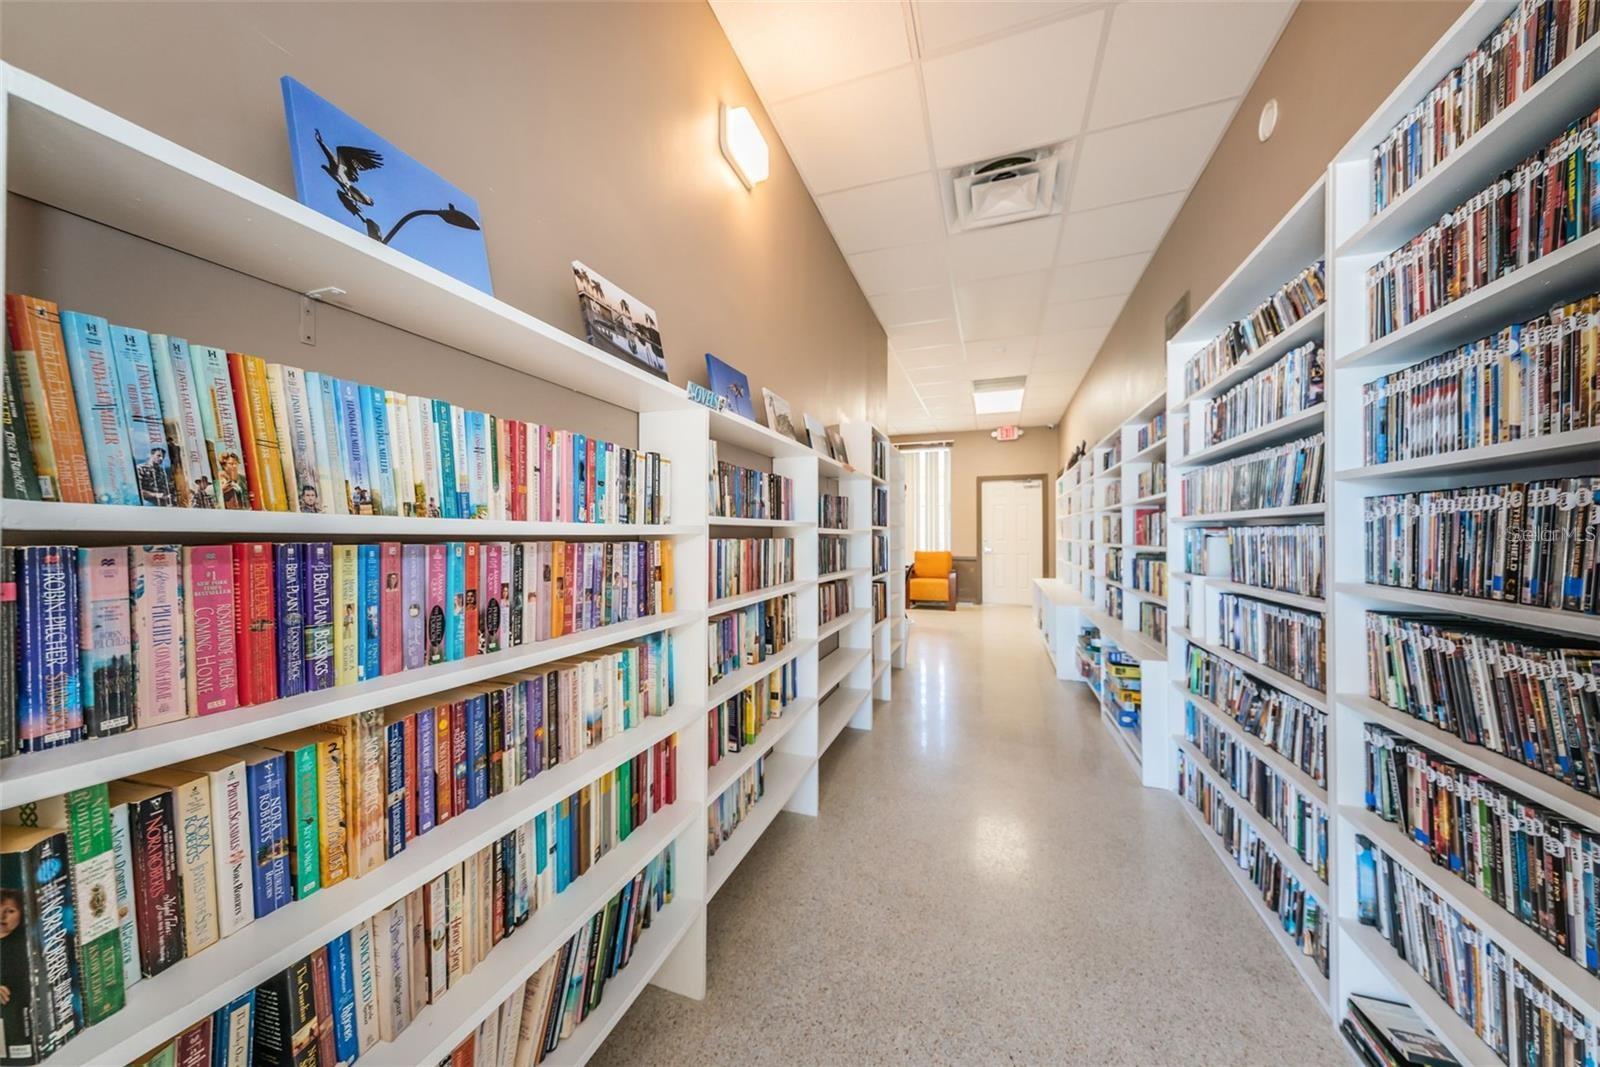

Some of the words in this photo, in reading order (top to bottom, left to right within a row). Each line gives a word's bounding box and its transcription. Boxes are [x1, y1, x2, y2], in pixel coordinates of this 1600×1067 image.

[38, 329, 60, 359] Linda
[44, 360, 66, 385] Lael
[88, 350, 106, 381] LINDA
[136, 364, 152, 390] LINDA
[176, 369, 189, 392] LINDA
[49, 386, 70, 422] Miller
[92, 383, 113, 405] LAEL
[140, 392, 154, 411] LAEL
[180, 393, 192, 410] LAEL
[214, 378, 228, 402] LINDA
[252, 388, 264, 412] LINDA
[290, 394, 302, 414] LINDA
[688, 381, 719, 410] NOVELS
[182, 411, 196, 436] MILLER
[218, 402, 232, 420] LAEL
[256, 413, 268, 430] LAEL
[292, 414, 304, 430] LAEL
[345, 402, 355, 422] LINDA
[374, 406, 384, 430] LINDA
[100, 408, 120, 446] MILLER
[144, 414, 162, 444] MILLER
[221, 422, 238, 450] MILLER
[294, 430, 308, 453] MILLER
[348, 422, 358, 438] LAEL
[376, 430, 386, 446] LAEL
[350, 439, 360, 462] MILLER
[378, 448, 388, 474] MILLER
[206, 570, 216, 580] #1
[286, 562, 298, 583] BELVA
[313, 573, 329, 598] BELVA
[42, 572, 66, 612] ROBIN
[254, 586, 270, 618] PLAIN
[286, 584, 298, 612] PLAIN
[151, 604, 172, 648] PILCHER
[314, 598, 329, 624] PLAIN
[44, 616, 68, 667] PILCHER
[194, 606, 214, 652] COMING
[216, 603, 233, 656] ROSAMUNDE
[290, 626, 301, 660] LOOKING
[314, 629, 329, 676] BLESSINGS
[196, 654, 216, 696] HOME
[218, 658, 234, 691] PILCHER
[290, 660, 302, 680] BACK
[156, 678, 172, 702] HOME
[1548, 690, 1564, 746] GLADIATOR
[364, 736, 379, 767] NORA
[227, 780, 242, 811] PRIVATE
[364, 766, 380, 816] ROBERTS
[70, 790, 90, 855] ROBERTS
[90, 796, 105, 836] NORA
[258, 792, 272, 844] ROBERTS
[270, 796, 282, 832] NORA
[392, 802, 402, 846] HOMEPORT
[146, 816, 163, 852] NORA
[184, 814, 199, 864] ROBERTS
[198, 815, 212, 855] NORA
[228, 810, 242, 852] SCANDALS
[146, 852, 166, 899] ROBERTS
[233, 863, 242, 884] NORA
[264, 870, 274, 899] RETURN
[274, 860, 285, 901] O'HURLEY'S
[39, 896, 64, 931] NORA
[234, 884, 244, 916] ROBERTS
[195, 912, 212, 936] SUN
[450, 916, 462, 946] Home
[42, 928, 69, 984] ROBERTS
[103, 946, 115, 968] KEY
[359, 930, 370, 966] TWICE
[450, 946, 463, 973] Song
[88, 943, 103, 1006] KNOWLEDGE
[106, 970, 116, 986] OF
[296, 963, 308, 984] The
[361, 967, 372, 1003] LOVED
[298, 982, 310, 1024] Guardian
[340, 1002, 354, 1042] Bygones
